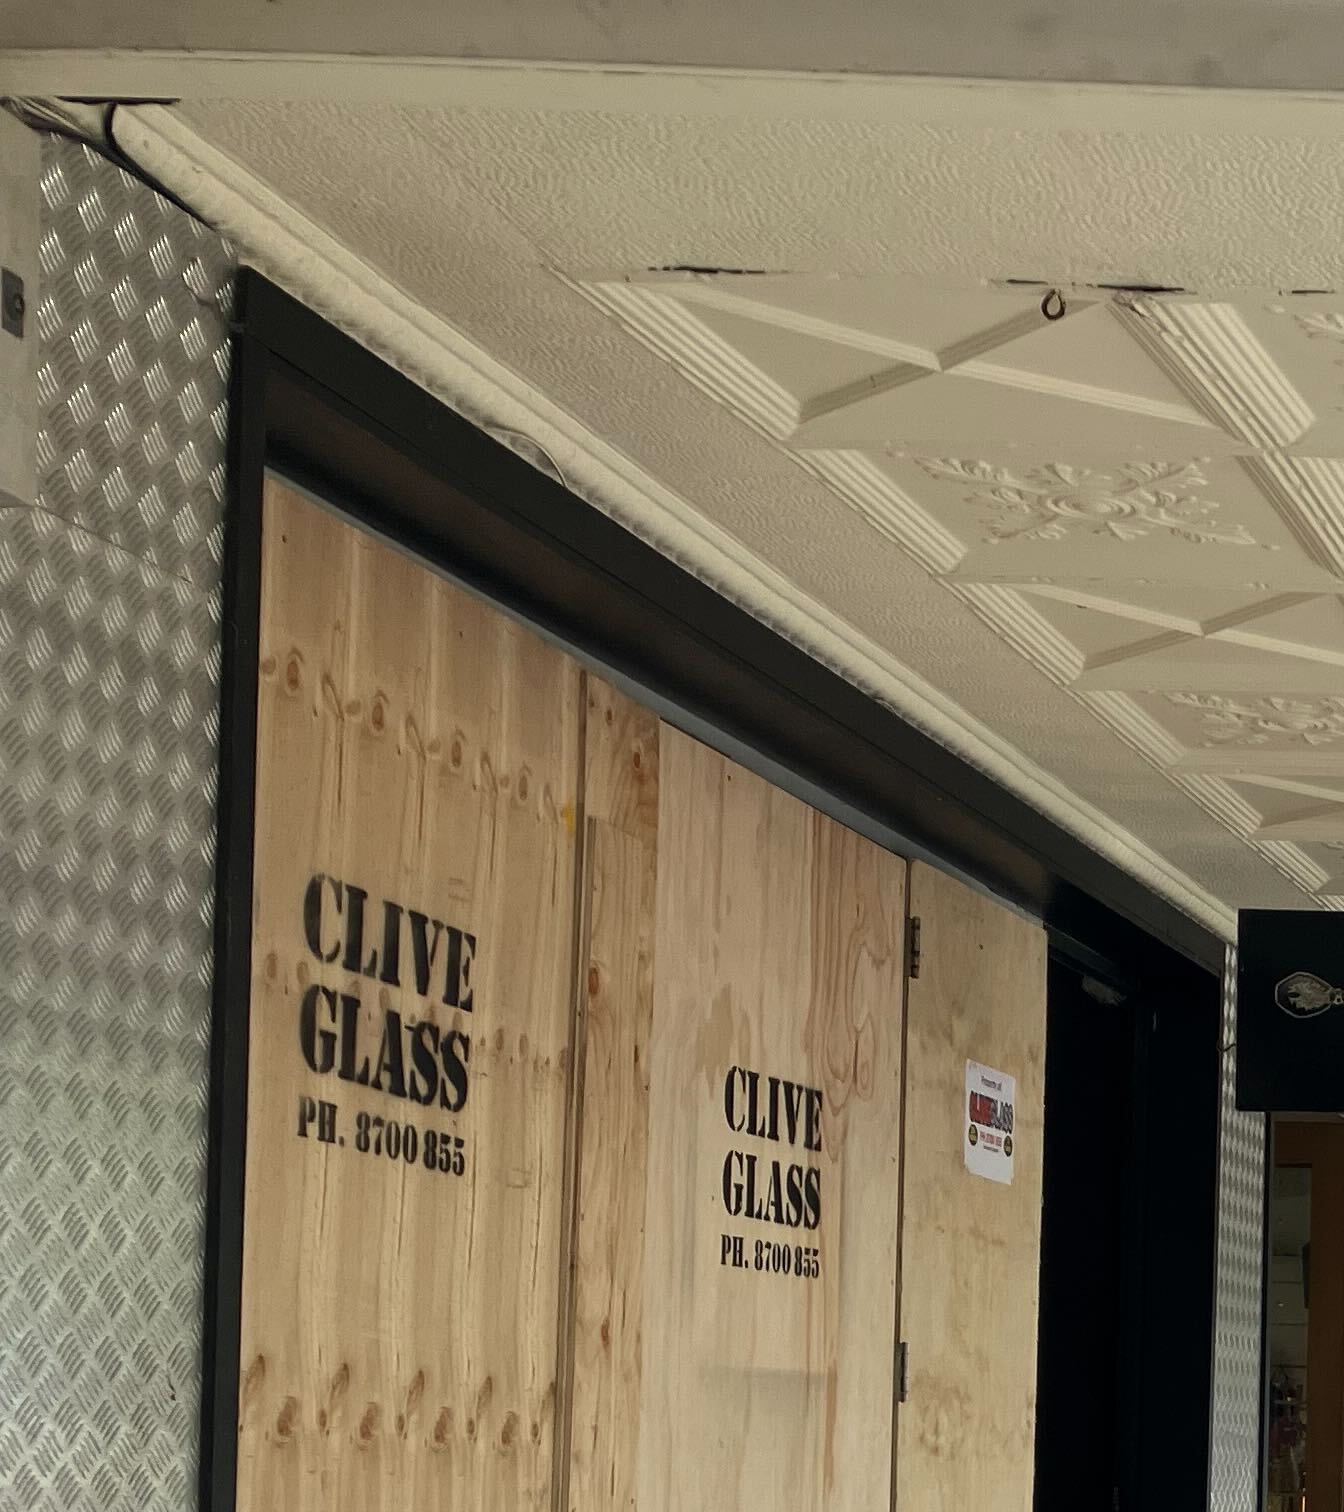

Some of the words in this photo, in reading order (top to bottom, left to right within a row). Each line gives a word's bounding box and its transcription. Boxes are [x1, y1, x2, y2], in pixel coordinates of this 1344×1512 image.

[303, 872, 477, 1013] CLIVE
[300, 984, 470, 1113] GLASS
[297, 1096, 345, 1148] PH.
[355, 1111, 418, 1165] 8700
[423, 1129, 465, 1177] 855
[724, 1065, 824, 1152] CLIVE
[722, 1150, 822, 1231] GLASS
[720, 1233, 749, 1269] PH.
[754, 1239, 791, 1275] 8700
[794, 1246, 820, 1279] 855
